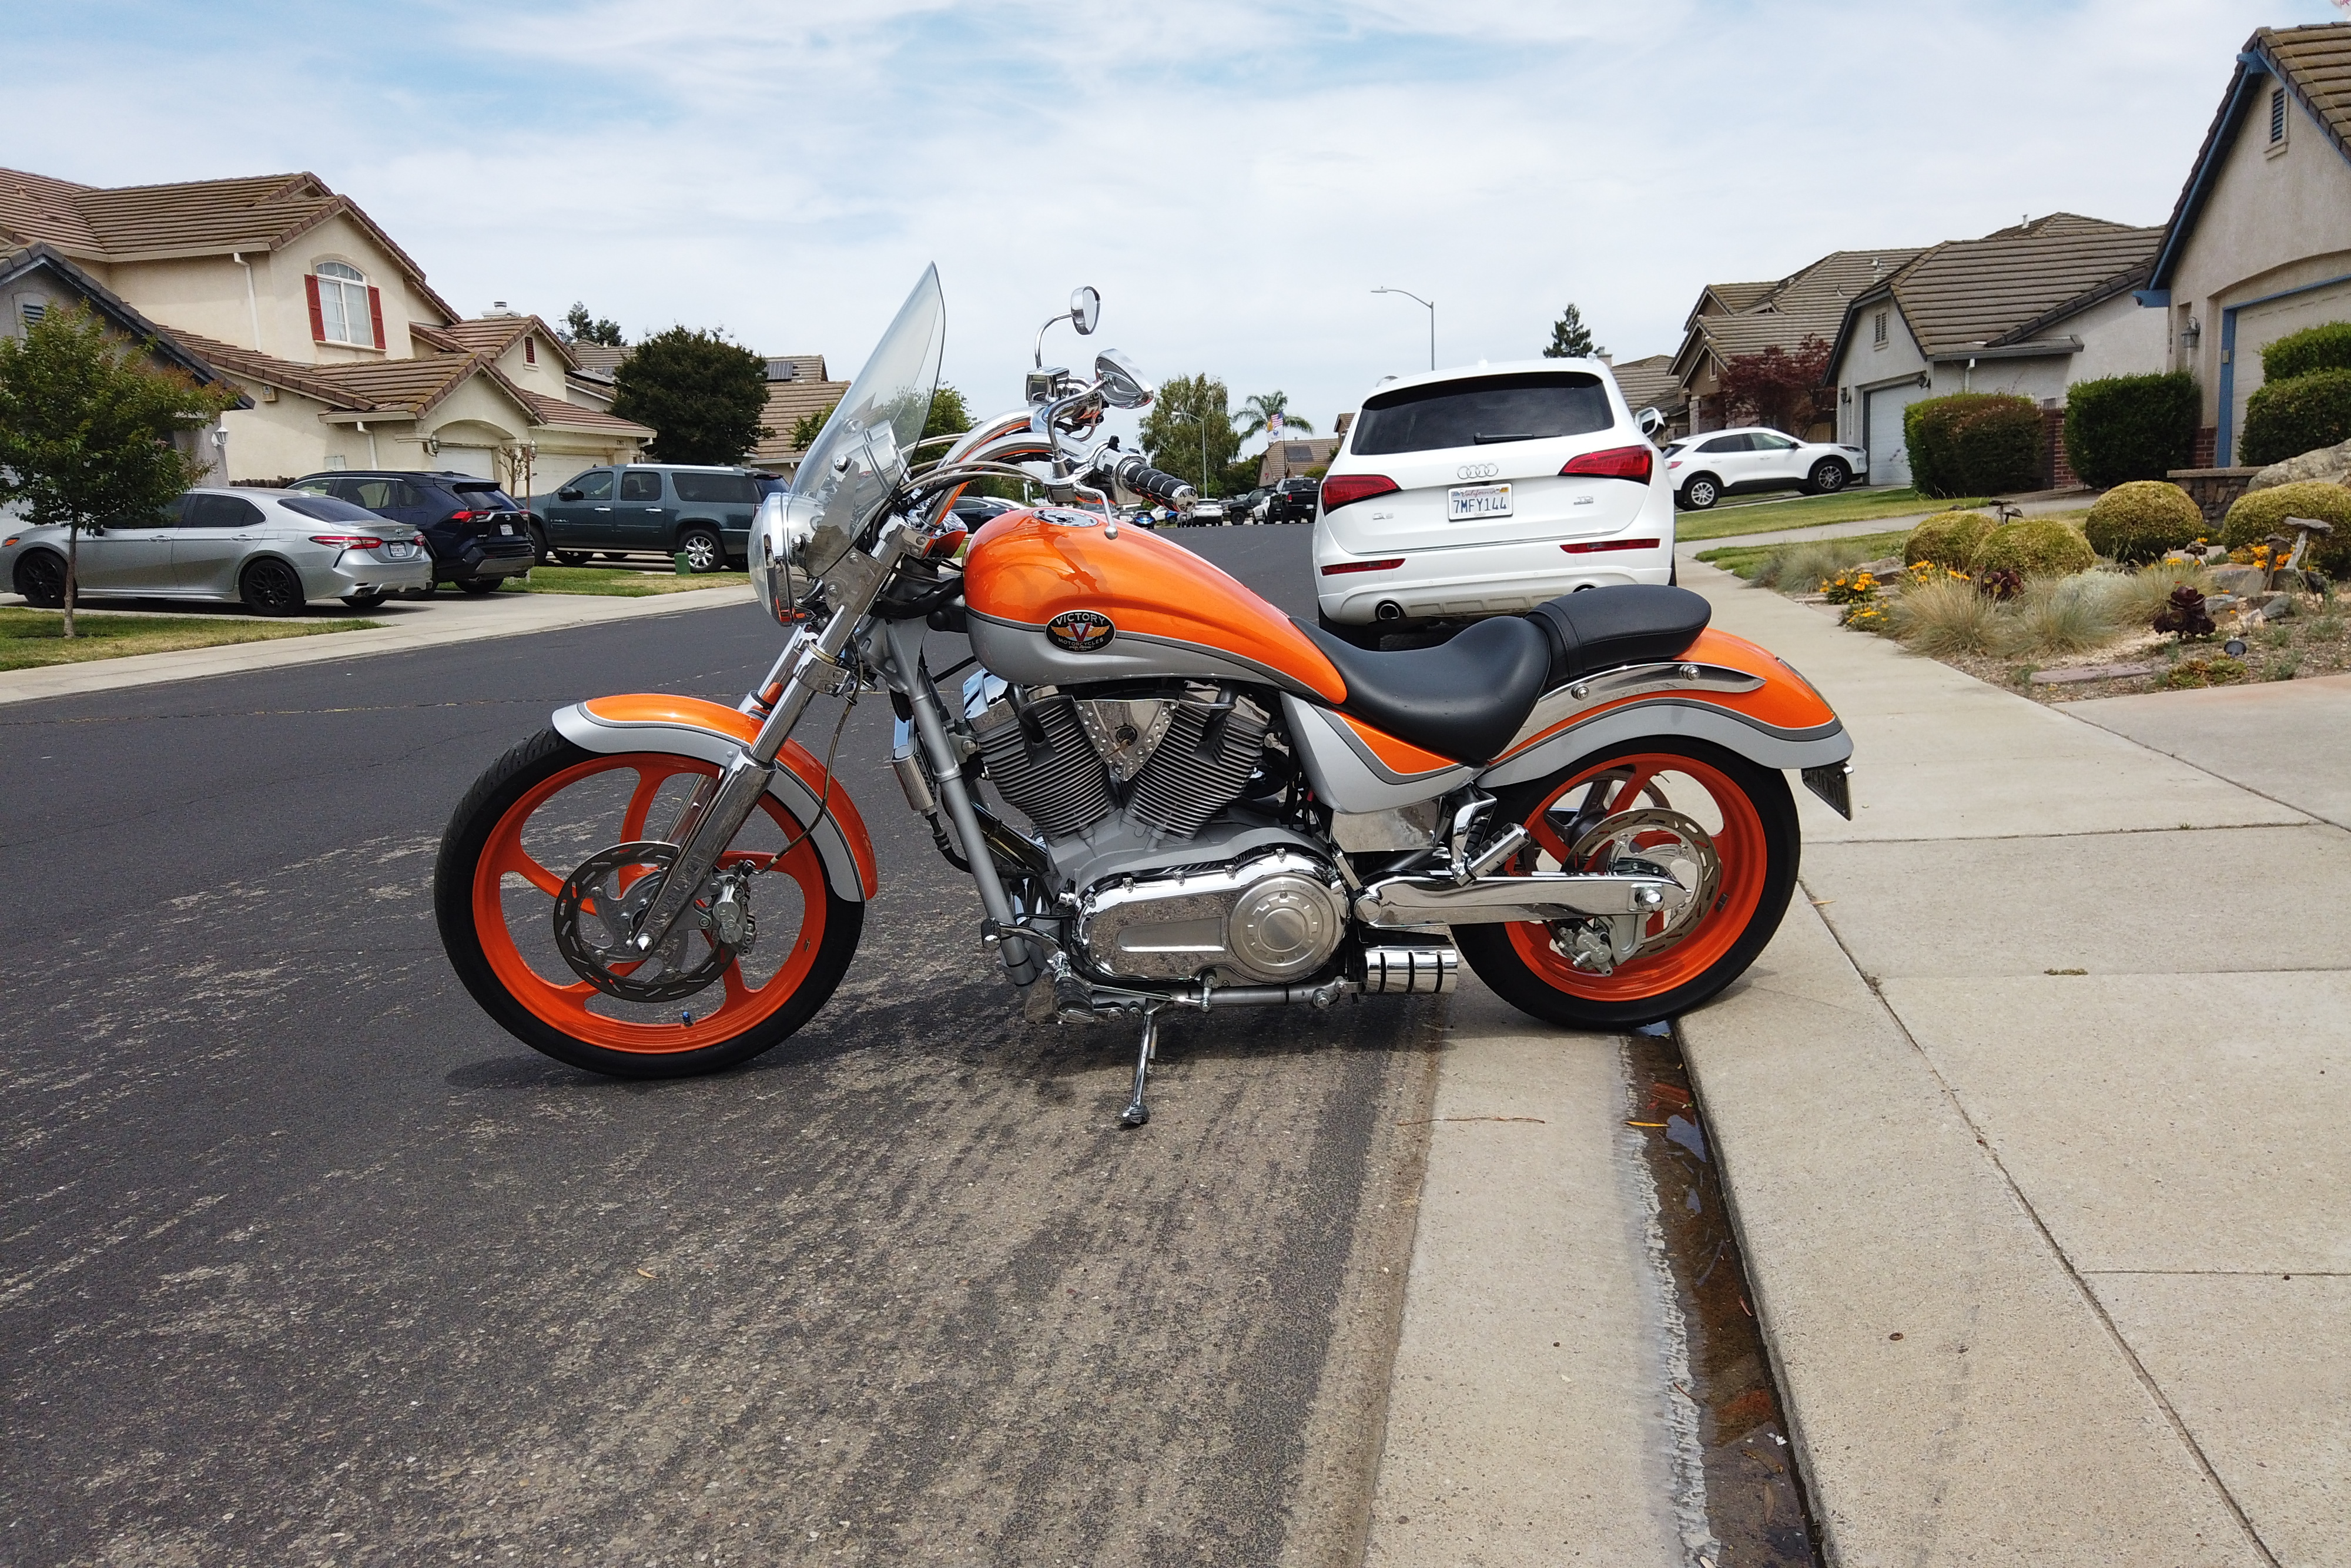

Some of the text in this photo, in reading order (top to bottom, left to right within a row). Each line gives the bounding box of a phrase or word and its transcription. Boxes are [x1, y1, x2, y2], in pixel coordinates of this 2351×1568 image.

[1453, 497, 1507, 514] 7MFY144
[1056, 613, 1105, 625] VICTORY
[1067, 622, 1093, 642] V
[1058, 637, 1104, 647] MOTORCYCLES
